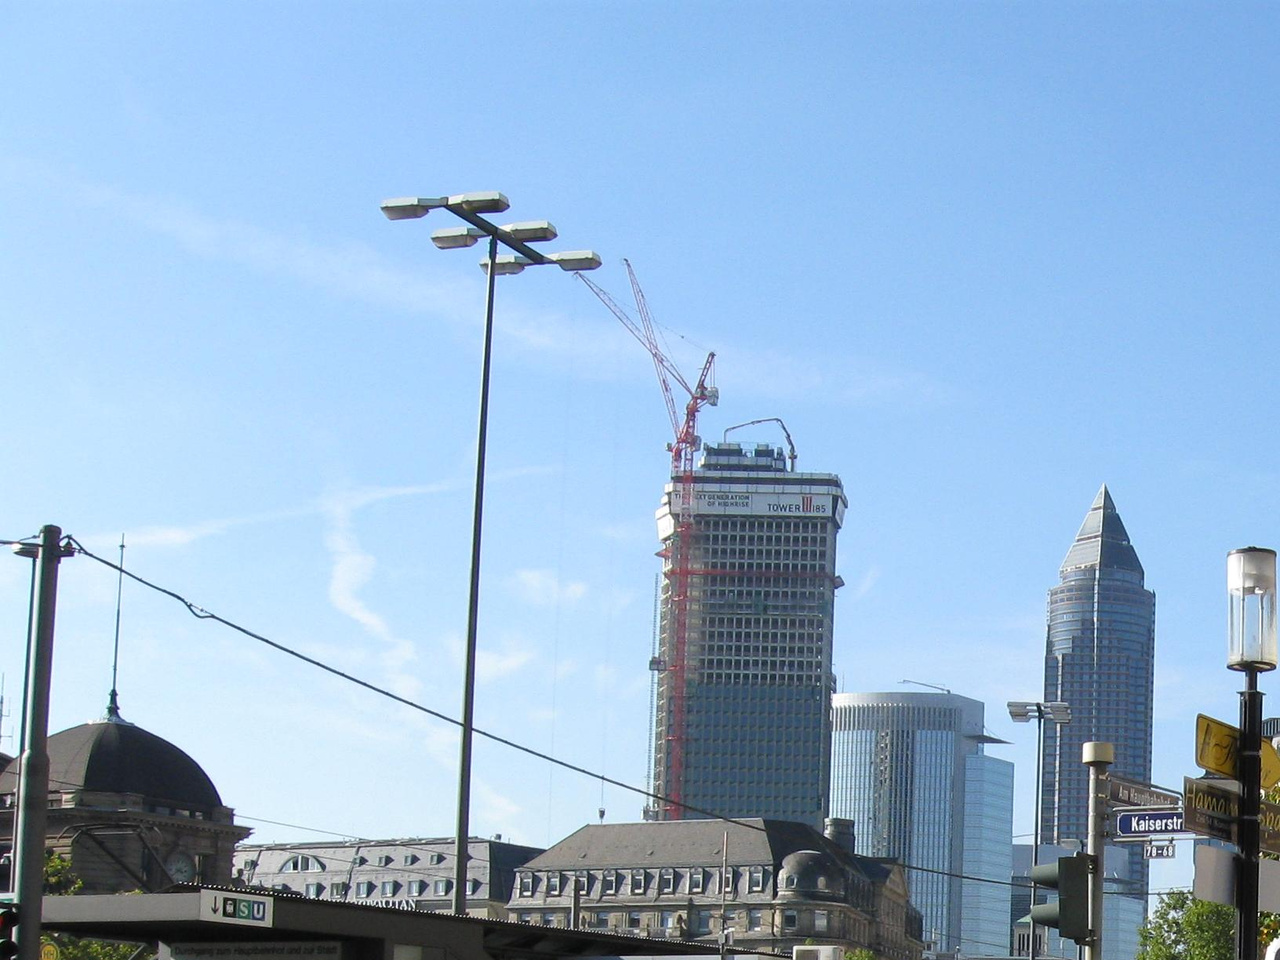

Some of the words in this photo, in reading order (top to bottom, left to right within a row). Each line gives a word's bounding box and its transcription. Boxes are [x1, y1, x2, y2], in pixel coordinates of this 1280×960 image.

[768, 503, 800, 513] TOWER
[812, 504, 826, 513] 185
[1146, 846, 1174, 857] 78-68
[238, 902, 249, 917] S
[253, 903, 264, 919] U
